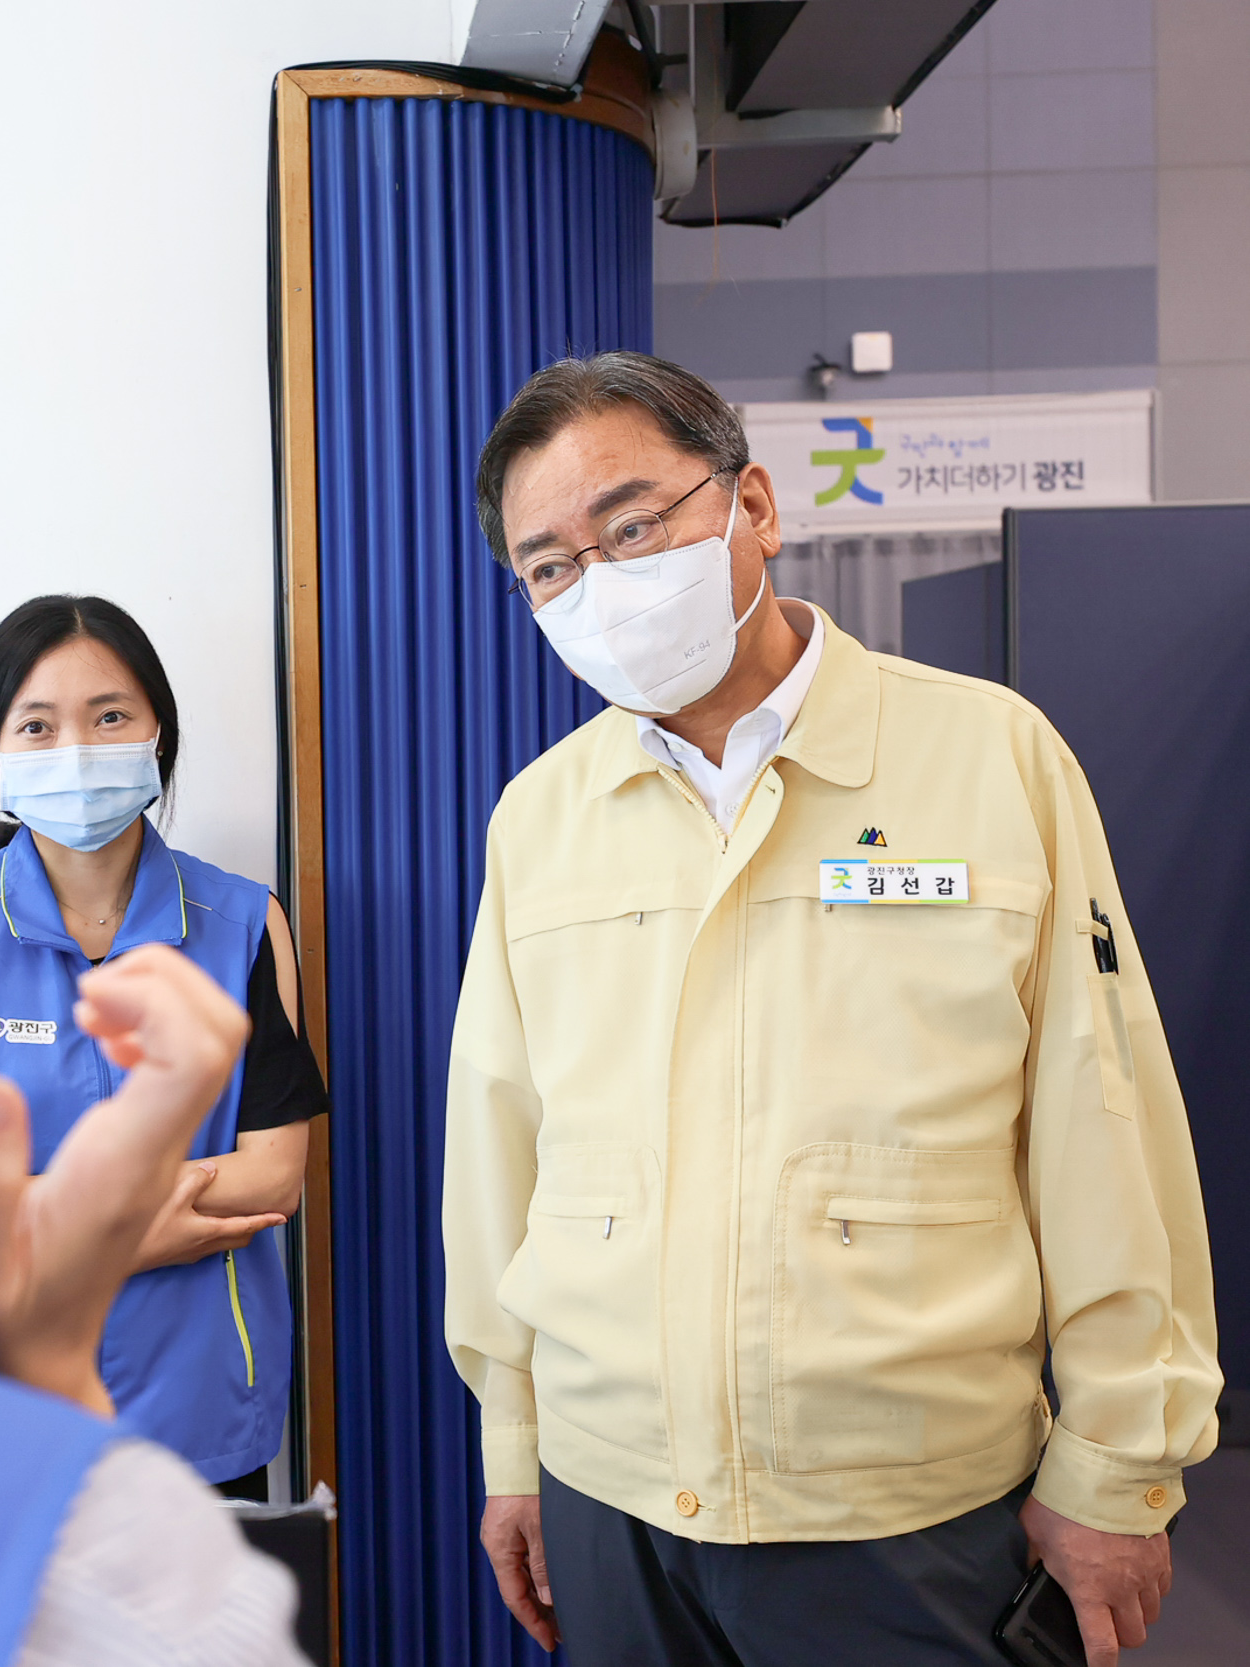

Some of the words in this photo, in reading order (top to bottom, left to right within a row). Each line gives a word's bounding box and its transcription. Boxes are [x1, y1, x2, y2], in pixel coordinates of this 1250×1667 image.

[897, 463, 1027, 494] 가치더하기
[1033, 460, 1085, 493] 광진
[867, 866, 915, 876] 광진구청장
[9, 1021, 53, 1034] 광진구
